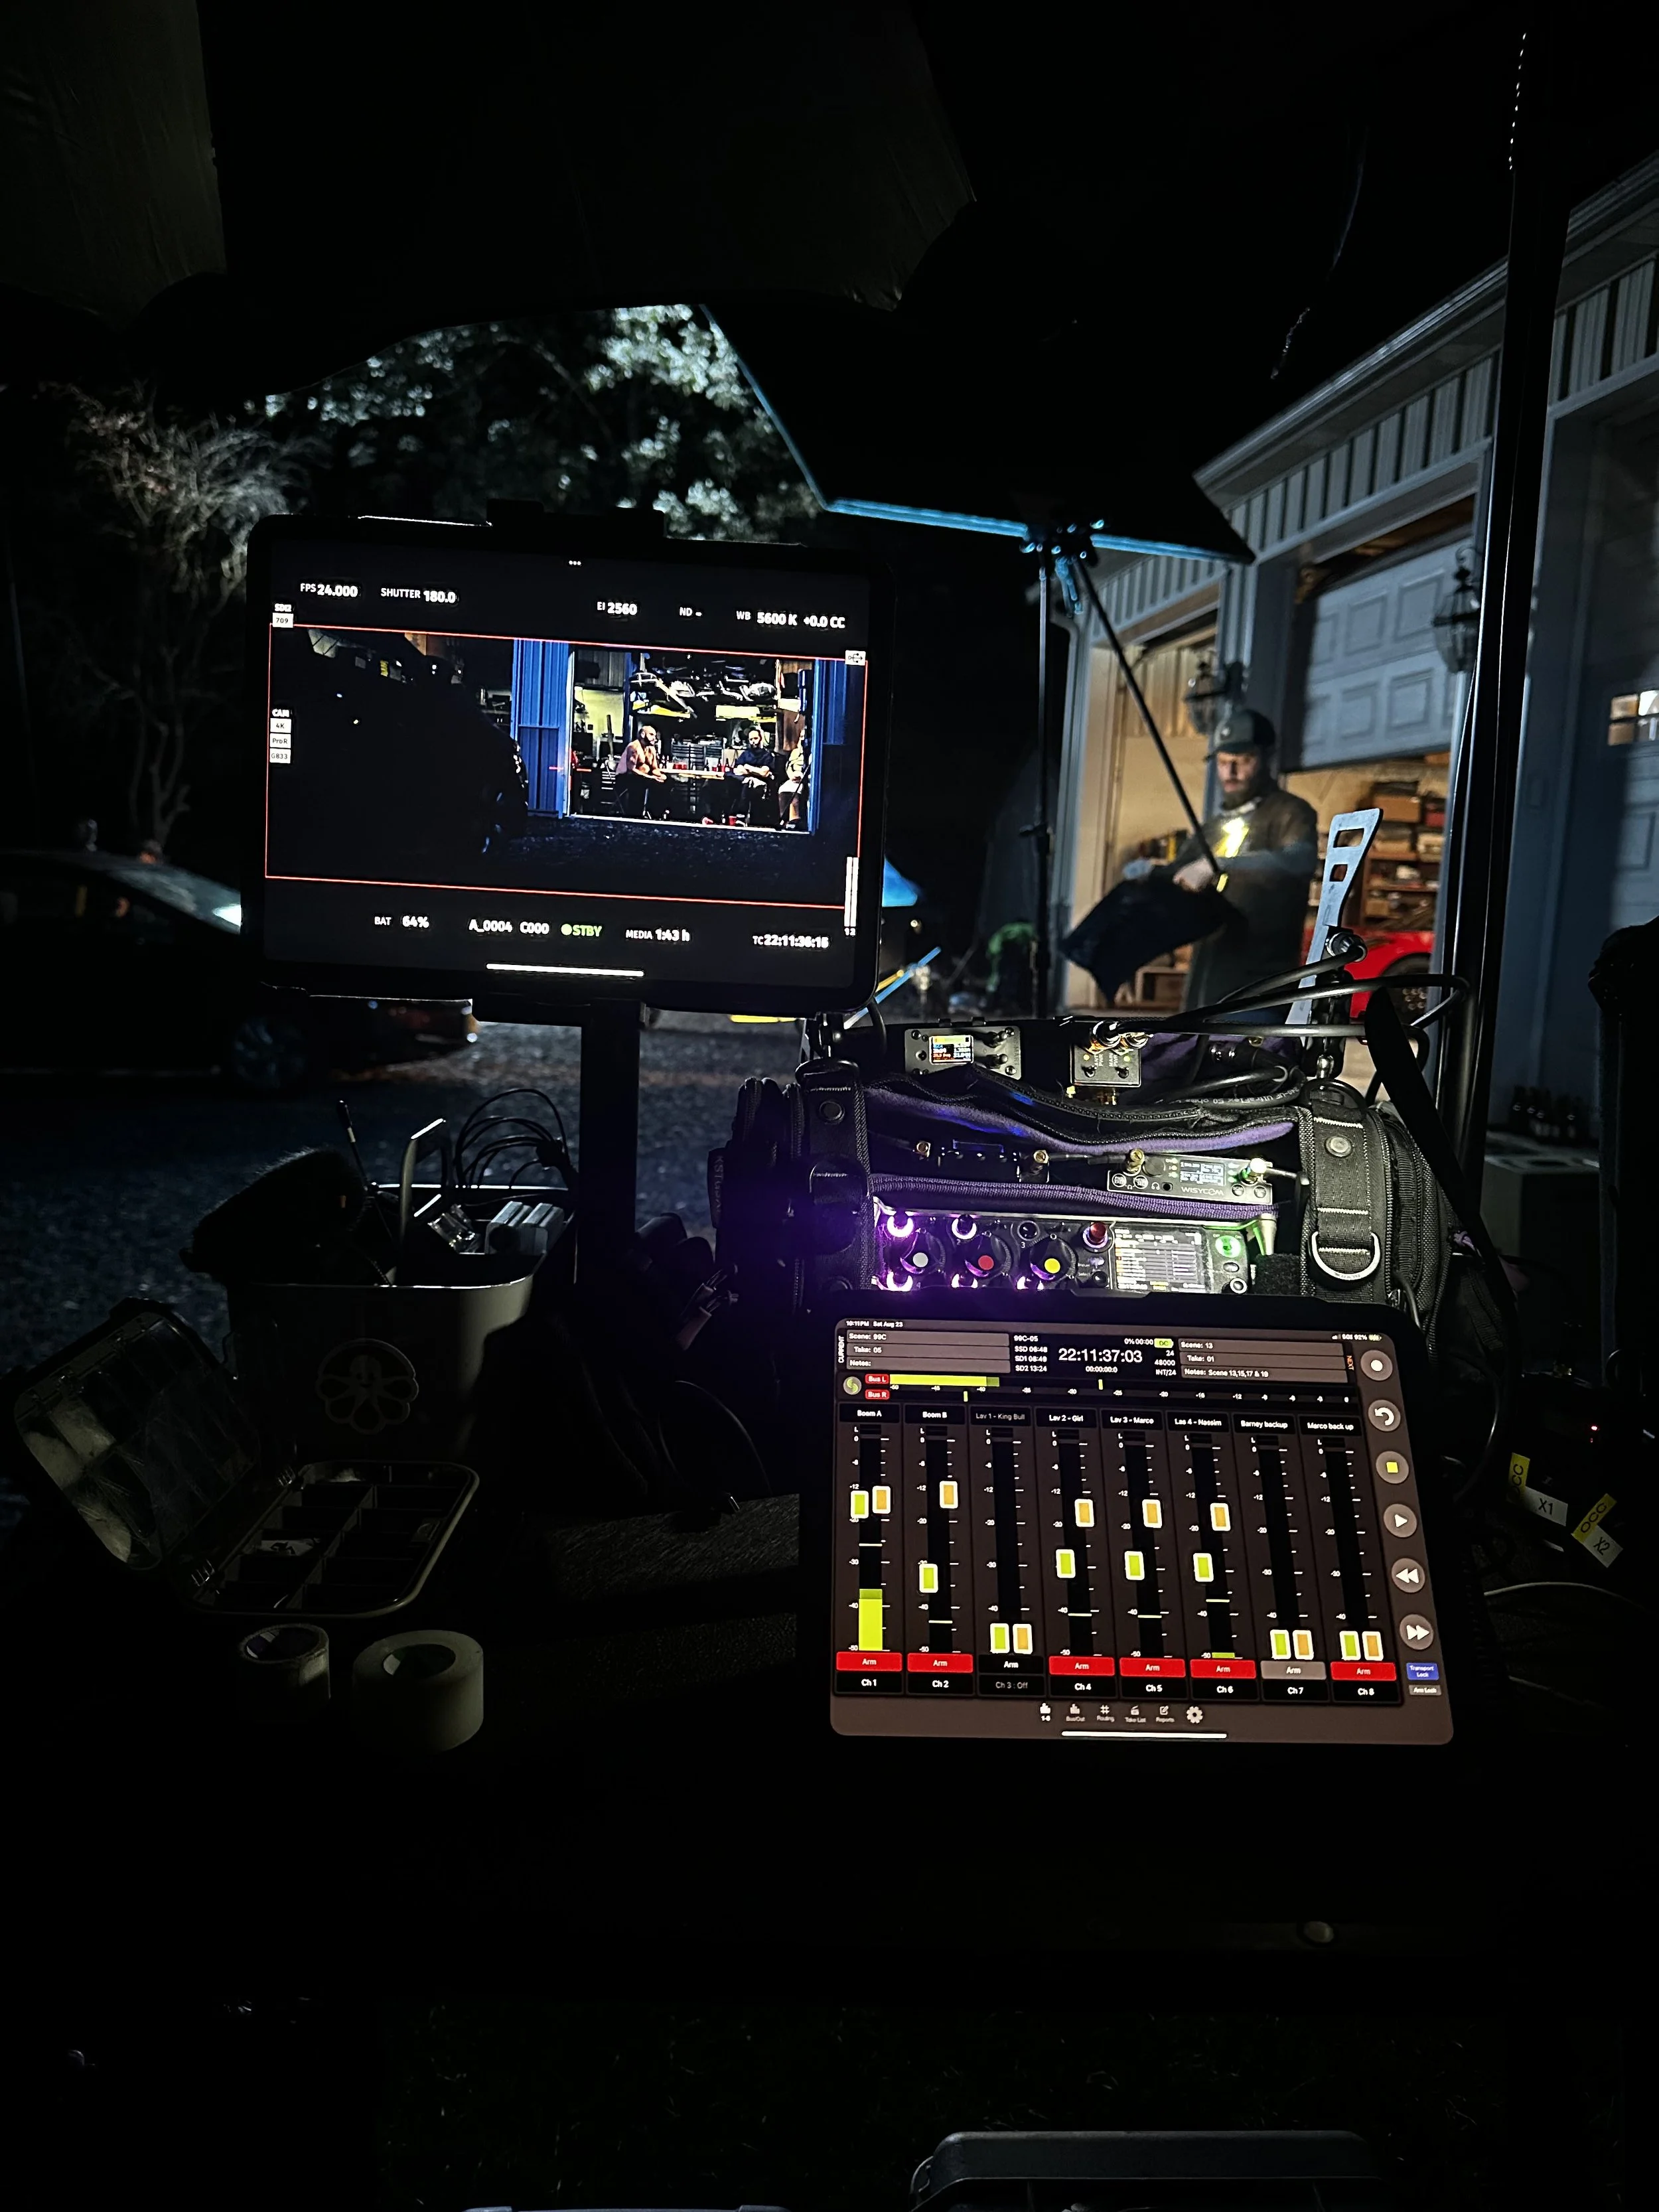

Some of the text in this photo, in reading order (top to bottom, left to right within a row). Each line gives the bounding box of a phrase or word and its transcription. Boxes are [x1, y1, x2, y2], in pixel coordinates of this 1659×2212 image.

[301, 583, 358, 597] FPS 24.000
[381, 588, 457, 603] SHUTTER 180.0
[607, 602, 637, 615] 2560
[680, 607, 692, 616] ND
[737, 611, 845, 628] WB 5600 K +0.0 CC
[272, 708, 289, 717] CAM
[375, 916, 429, 928] BAT 64%
[469, 919, 549, 934] A_0004 C000
[626, 930, 652, 939] MEDIA
[682, 929, 689, 941] h
[753, 936, 764, 945] TC
[1229, 1094, 1273, 1104] UltraFlex
[1181, 1187, 1224, 1196] WISYCOM
[1058, 1348, 1142, 1363] 22:11:37:03
[1538, 1498, 1553, 1515] X1
[1581, 1503, 1607, 1533] OCC
[1593, 1537, 1611, 1556] X2
